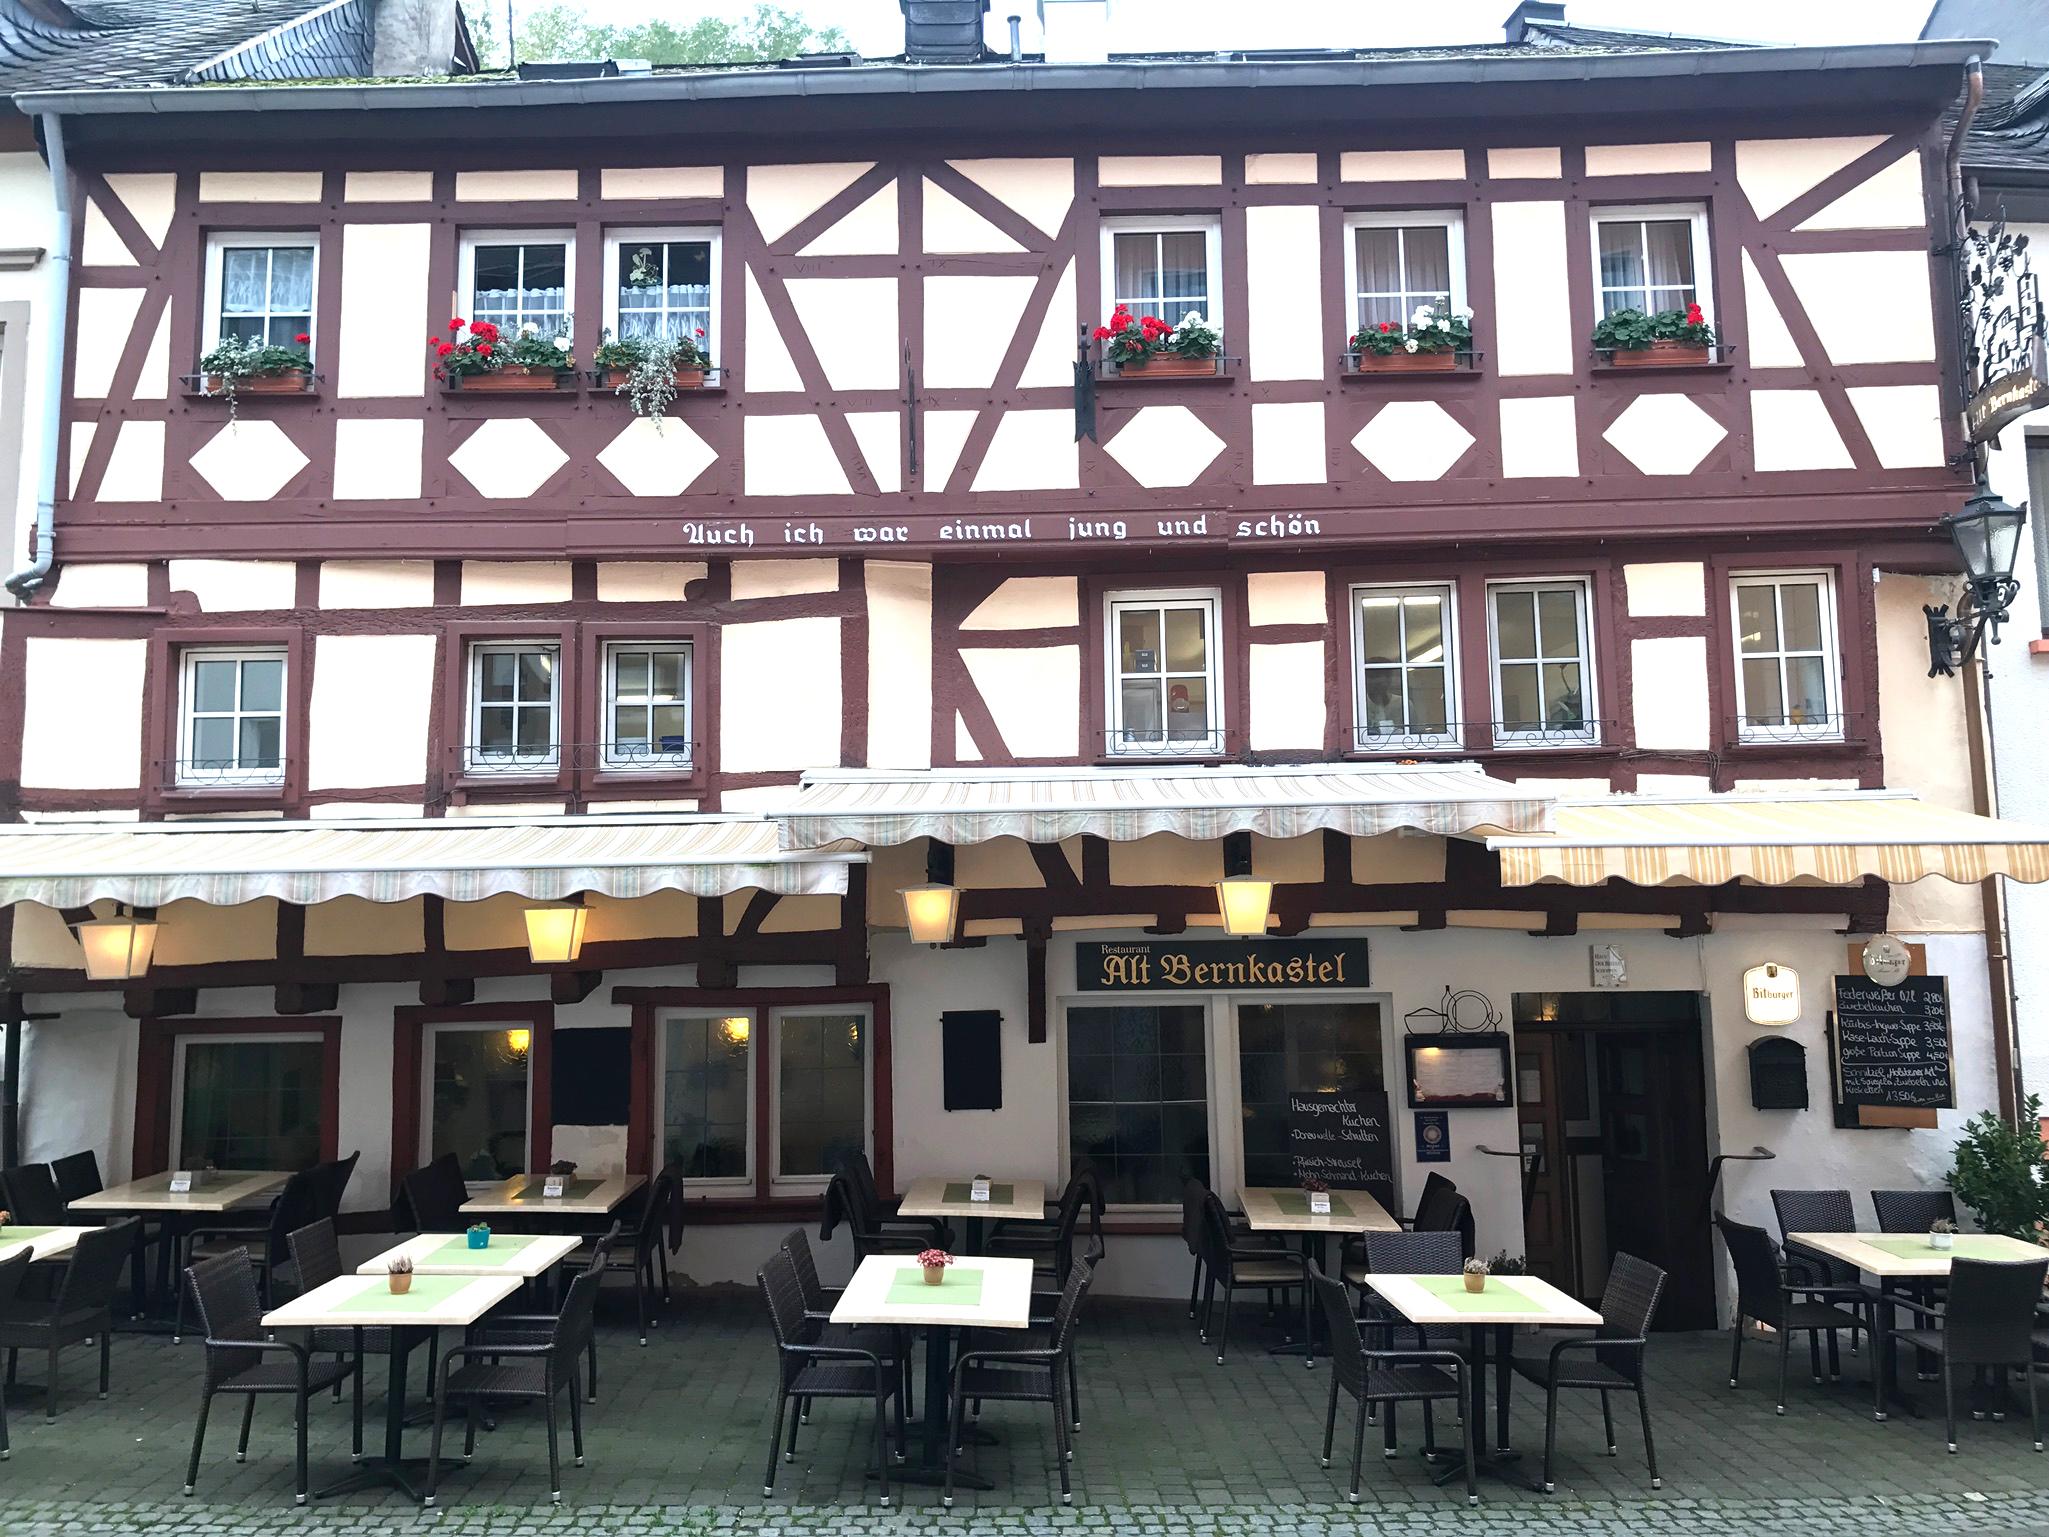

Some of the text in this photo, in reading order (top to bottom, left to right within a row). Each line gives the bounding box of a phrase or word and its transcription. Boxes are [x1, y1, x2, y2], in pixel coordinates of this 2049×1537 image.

[682, 513, 1321, 548] Auch ich war einmal jung und schön
[1101, 944, 1151, 954] Restaurant
[1101, 952, 1347, 985] Alt Bernkastel
[1752, 986, 1794, 1000] Bitburger
[1838, 987, 1896, 1002] Federweißer
[1342, 1114, 1380, 1127] Kuchen
